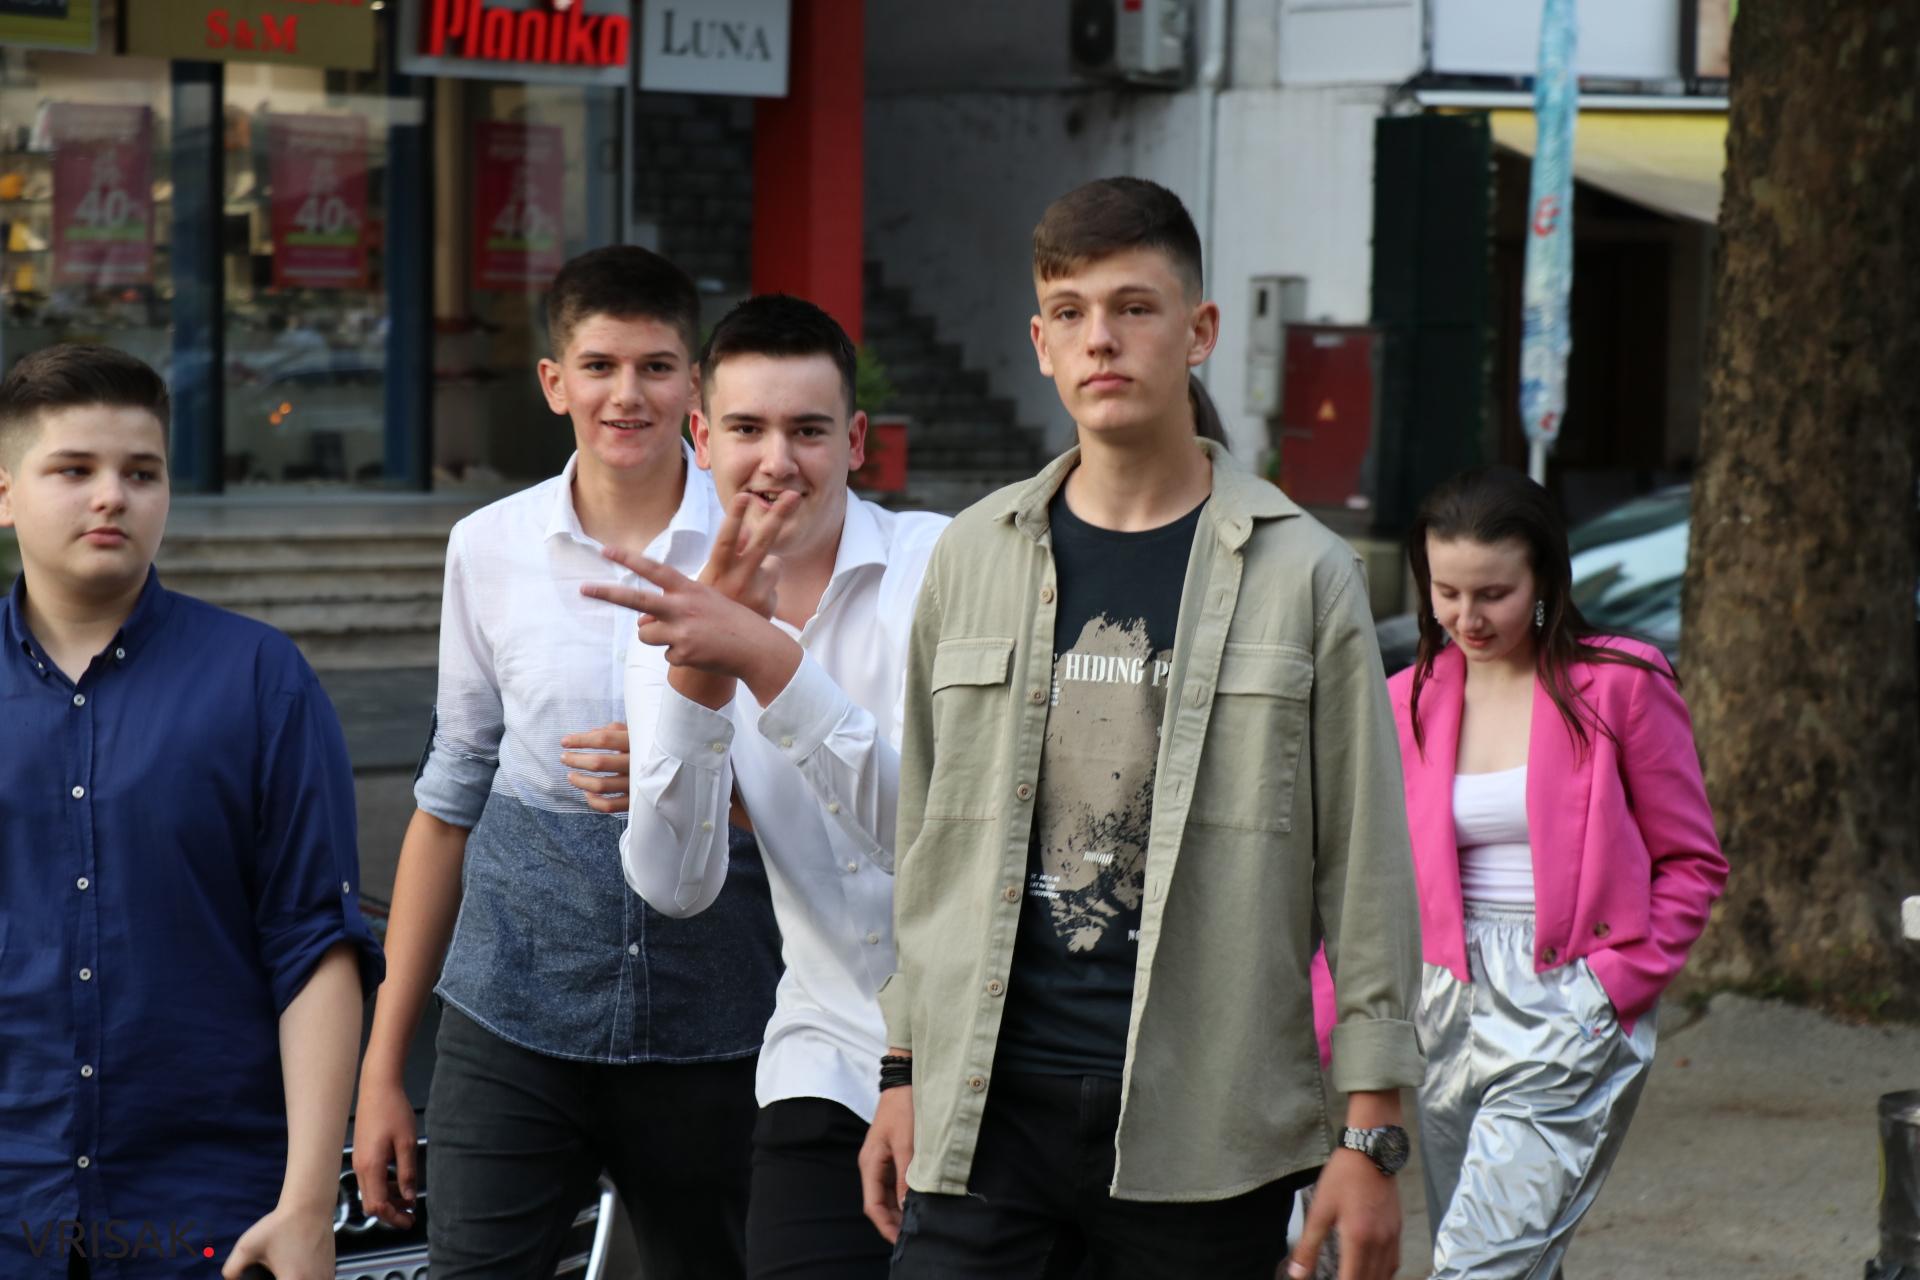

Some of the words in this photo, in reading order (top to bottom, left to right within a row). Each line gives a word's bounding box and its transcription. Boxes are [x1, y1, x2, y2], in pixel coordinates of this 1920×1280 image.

[205, 8, 298, 53] S&M
[429, 0, 630, 67] Planika
[661, 9, 771, 61] LUNA
[1065, 653, 1144, 685] HIDING
[1152, 660, 1170, 688] P
